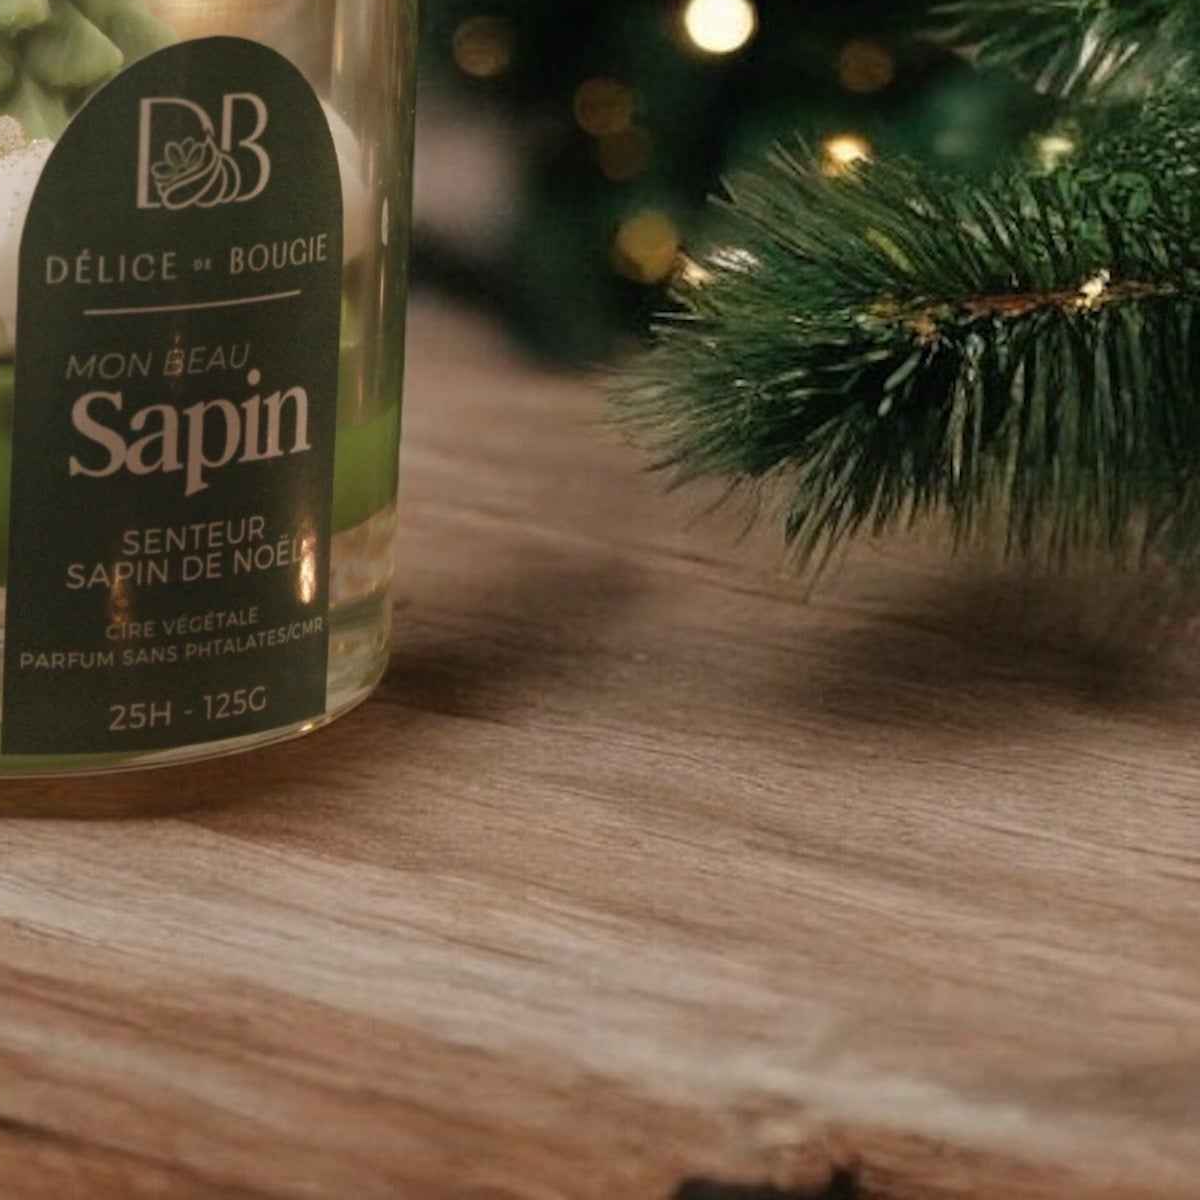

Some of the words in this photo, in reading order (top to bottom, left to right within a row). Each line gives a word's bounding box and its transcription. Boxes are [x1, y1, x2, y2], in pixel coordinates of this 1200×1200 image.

[45, 249, 178, 284] DÉLICE
[194, 259, 212, 271] DE
[229, 234, 328, 275] BOUGIE
[65, 351, 153, 380] MON
[162, 343, 251, 377] BEAU
[68, 368, 312, 498] Sapin
[122, 515, 265, 556] SENTEUR
[65, 561, 169, 590] SAPIN
[181, 552, 222, 582] DE
[233, 532, 304, 576] NOËL
[19, 650, 115, 669] PARFUM
[122, 645, 178, 667] SANS
[185, 617, 324, 660] PHTALATES/CMR
[105, 620, 156, 641] CIRE
[162, 606, 260, 637] VÉGÉTALE
[108, 701, 172, 731] 25H
[203, 686, 268, 720] 125G
